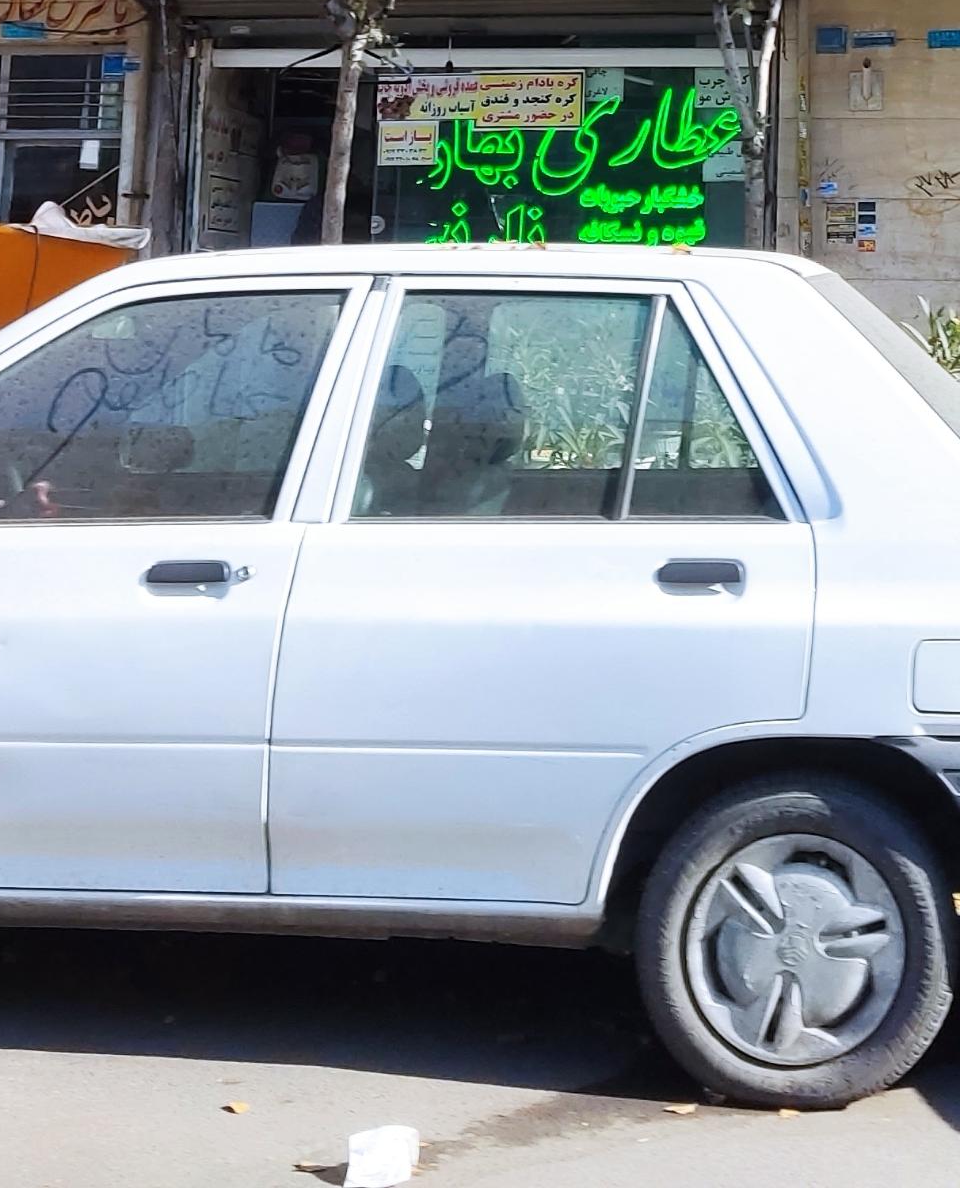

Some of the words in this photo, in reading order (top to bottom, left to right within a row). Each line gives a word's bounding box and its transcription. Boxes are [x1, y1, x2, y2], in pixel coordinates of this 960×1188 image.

[526, 77, 554, 91] بادام
[556, 77, 578, 91] کره
[480, 94, 510, 107] فندق
[512, 98, 520, 107] و
[522, 93, 553, 107] کنجد
[554, 93, 577, 107] کره
[481, 110, 521, 123] مشتری
[522, 110, 557, 123] حضور
[559, 111, 575, 123] در
[531, 88, 742, 196] عطاری
